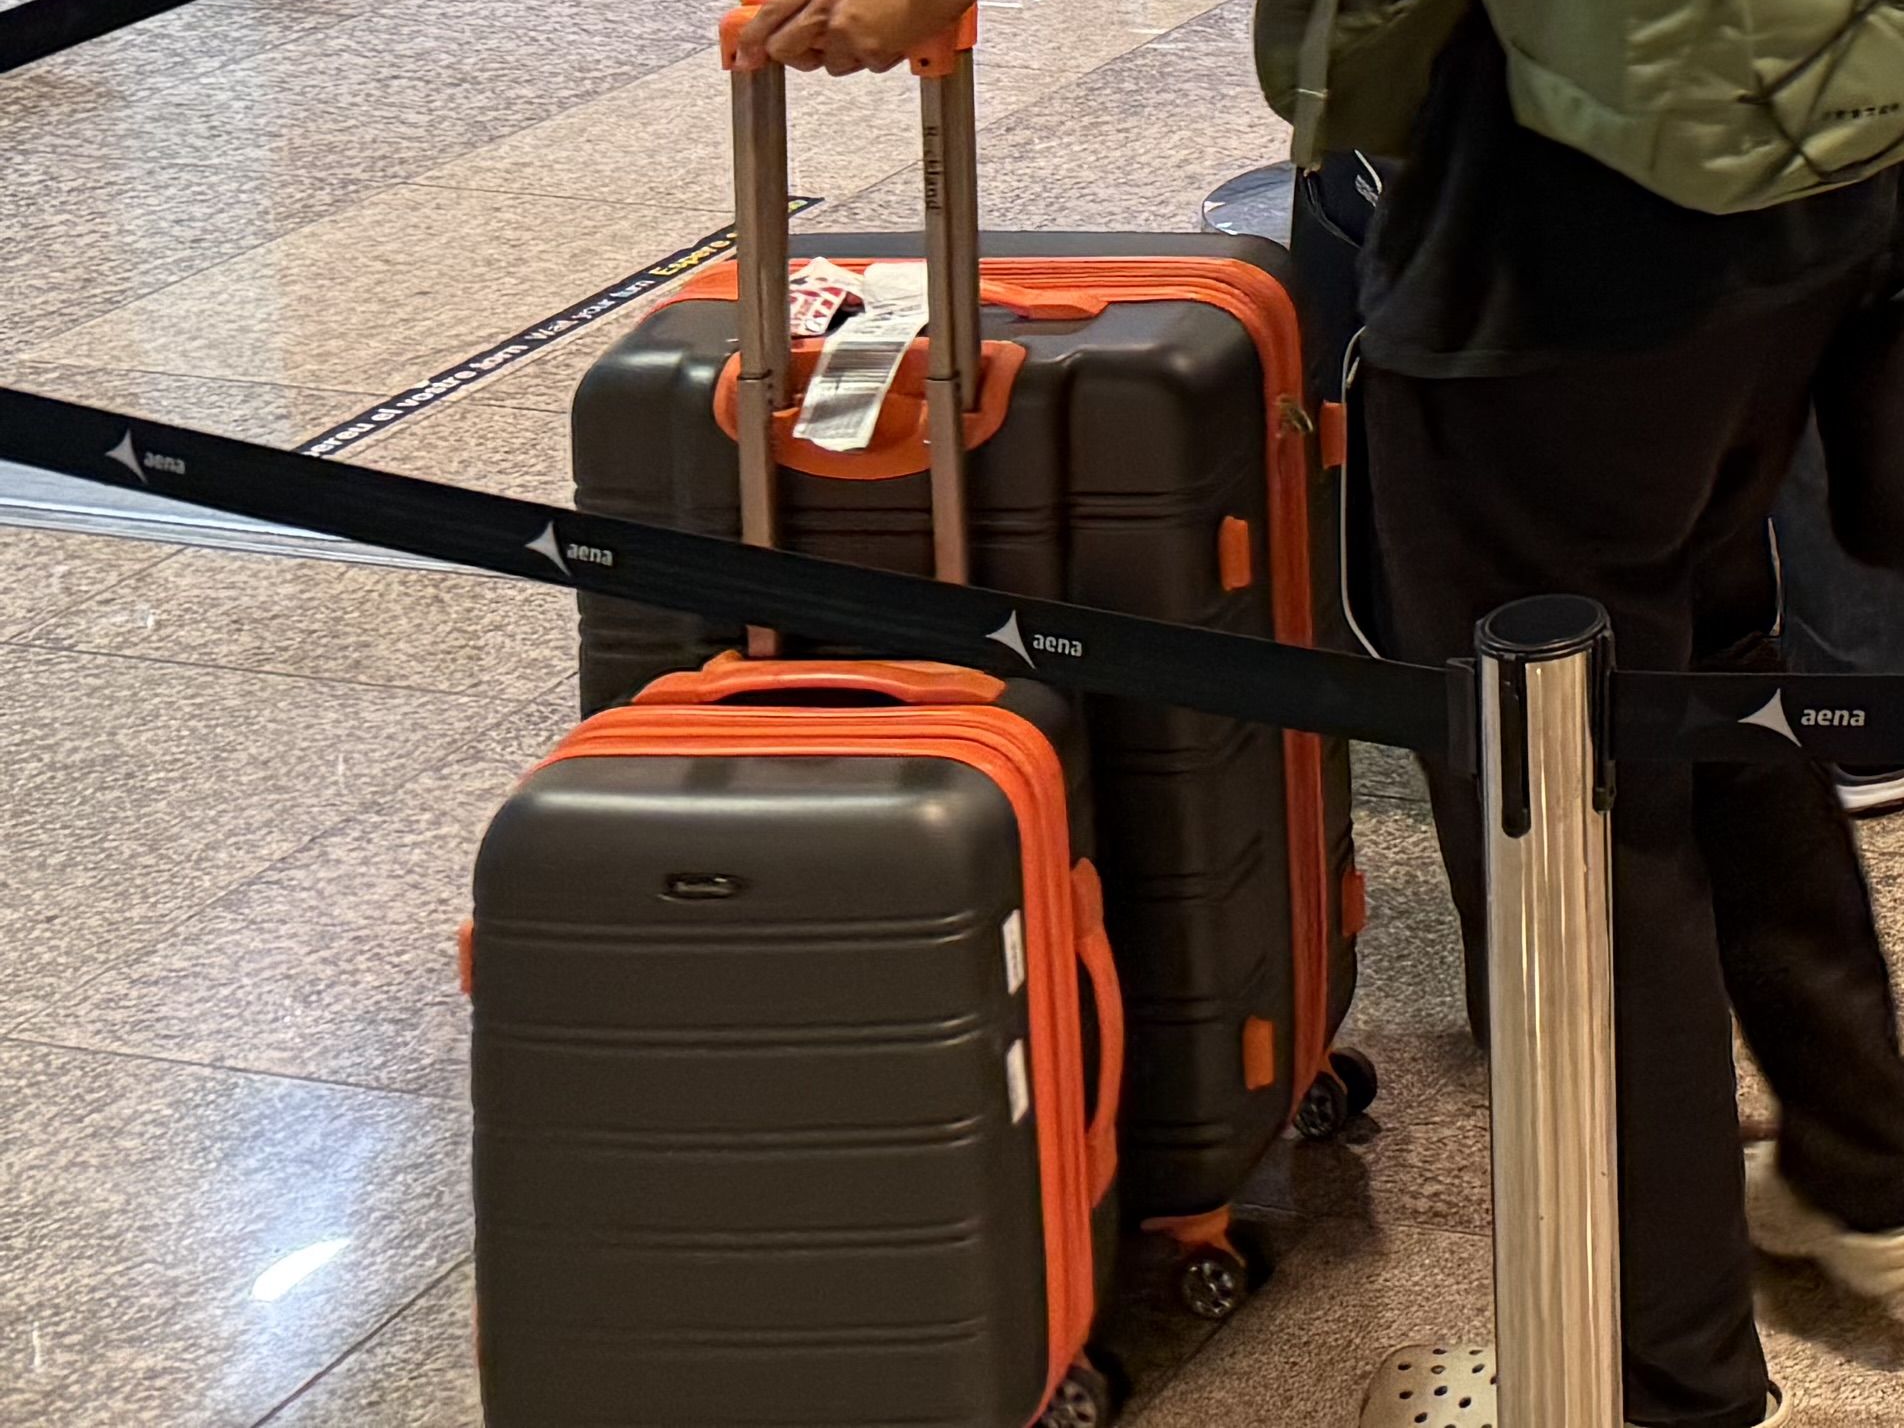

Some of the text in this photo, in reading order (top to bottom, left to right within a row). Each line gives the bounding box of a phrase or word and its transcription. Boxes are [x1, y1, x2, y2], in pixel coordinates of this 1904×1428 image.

[371, 406, 397, 426] el
[396, 370, 477, 409] vostre
[144, 445, 187, 478] aena
[566, 541, 615, 570] aena
[1031, 630, 1084, 660] aena
[1801, 704, 1866, 732] aena
